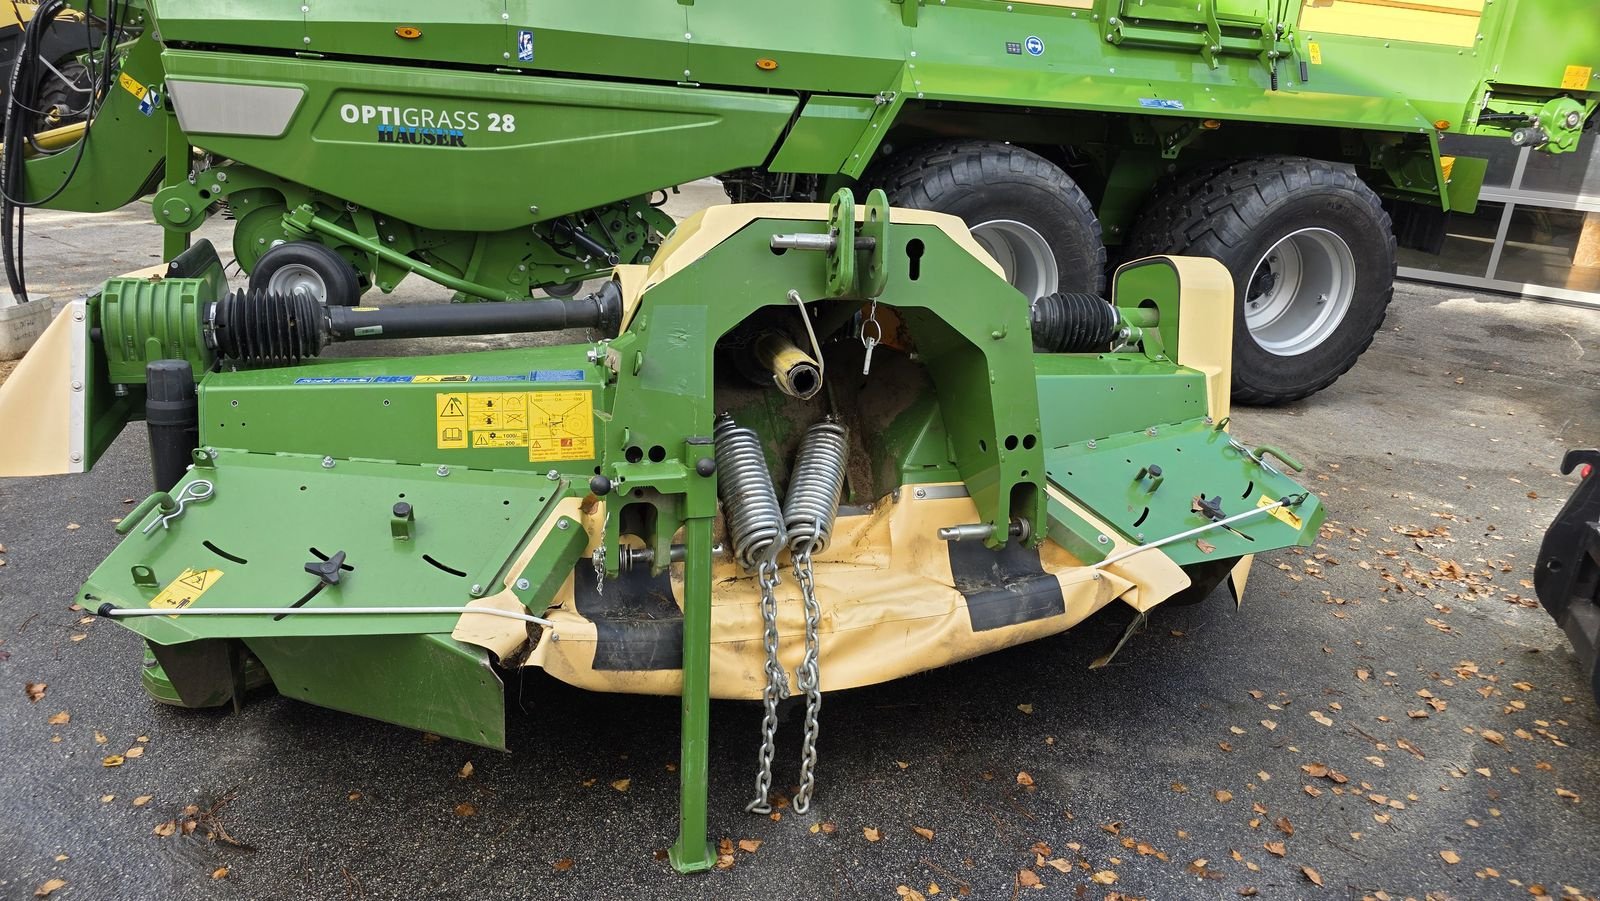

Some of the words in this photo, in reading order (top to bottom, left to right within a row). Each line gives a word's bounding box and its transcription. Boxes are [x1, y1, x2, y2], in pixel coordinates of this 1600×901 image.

[340, 103, 480, 131] OPTIGRASS
[487, 112, 516, 133] 28
[377, 123, 467, 148] HAUSER
